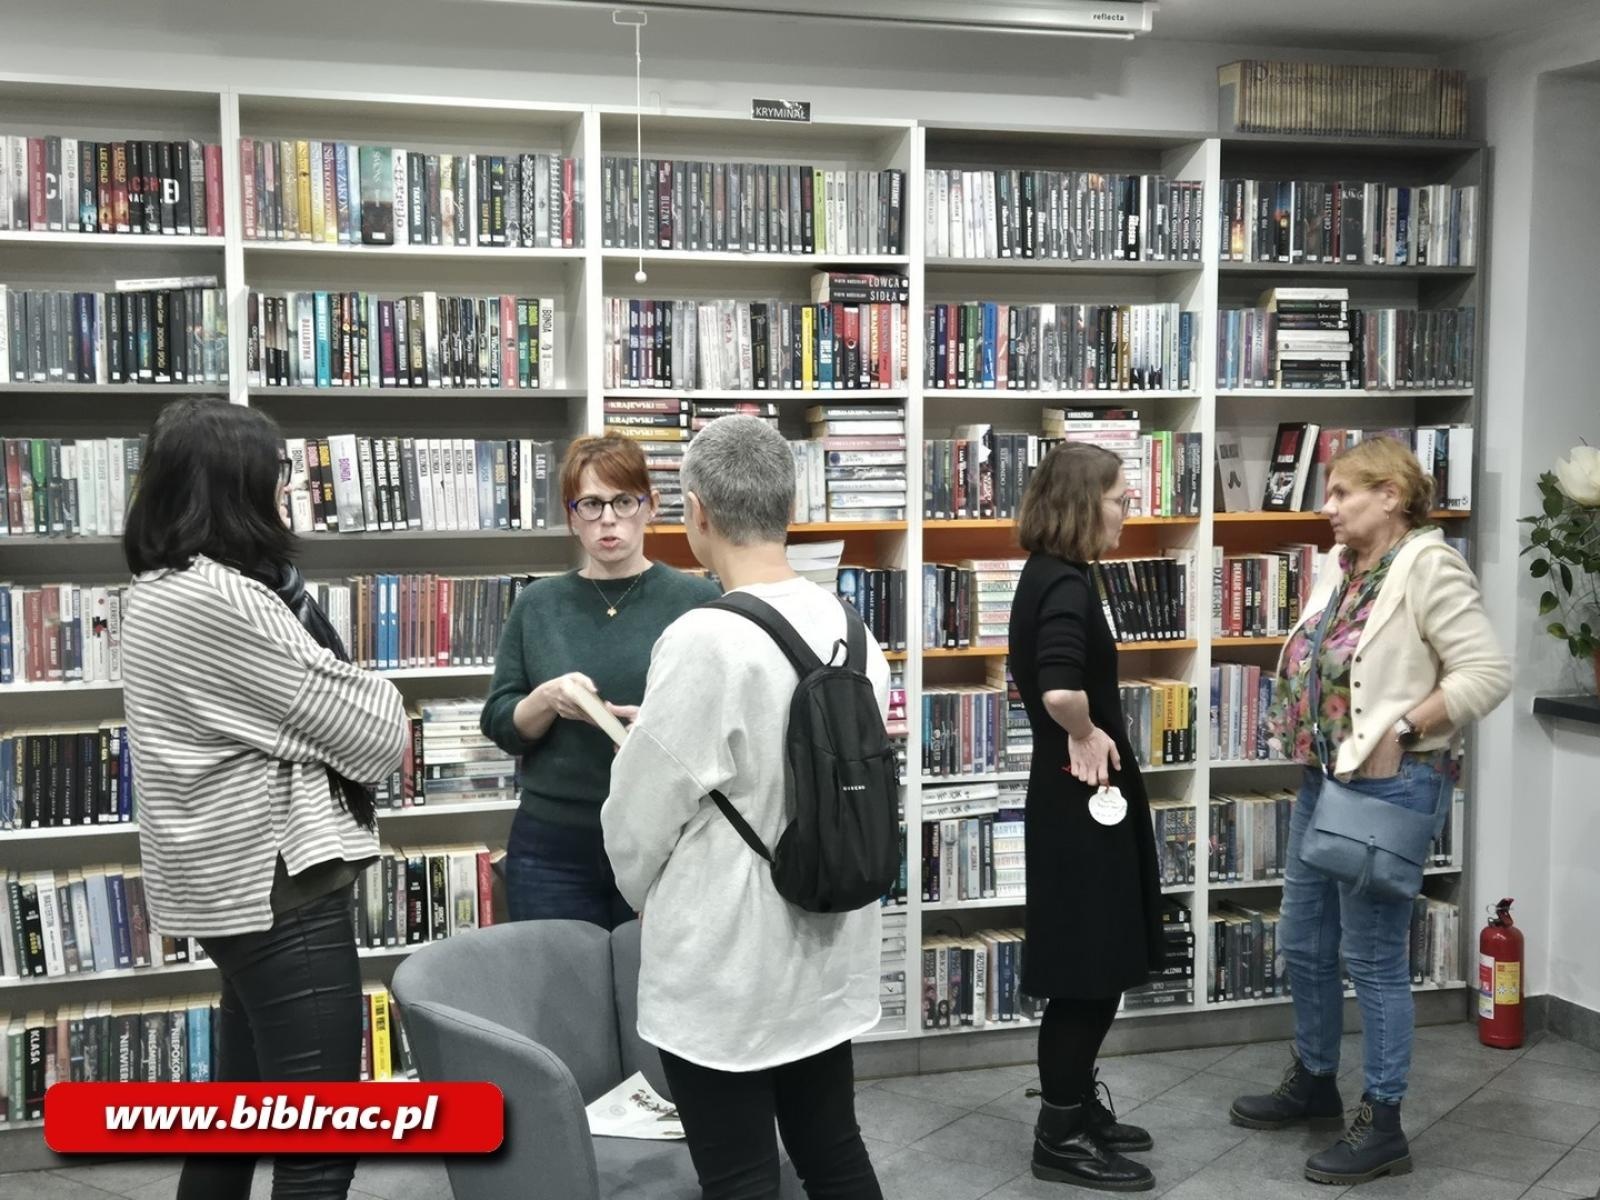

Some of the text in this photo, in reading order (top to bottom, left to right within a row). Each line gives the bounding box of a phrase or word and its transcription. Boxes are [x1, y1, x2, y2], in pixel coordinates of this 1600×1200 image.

[100, 161, 108, 184] CHILD
[117, 147, 127, 183] LEE CHILD
[1182, 219, 1190, 250] OHLSSON
[869, 277, 900, 288] ŁOWCA
[870, 290, 897, 301] SIDŁA
[542, 309, 553, 333] BONDA
[611, 402, 654, 410] KRAJEWSKI
[617, 427, 653, 436] RAJEWSKI
[293, 449, 304, 474] BONDA
[338, 458, 352, 483] BONDA
[360, 439, 372, 486] PIOTR BORLIK
[375, 439, 387, 486] PIOTR BORLIK
[387, 439, 399, 486] PIOTR BORLIK
[535, 454, 546, 479] LALKI
[1233, 563, 1243, 591] DEKALOG
[1212, 567, 1223, 618] DZIEKAN
[30, 1029, 40, 1064] KLASA
